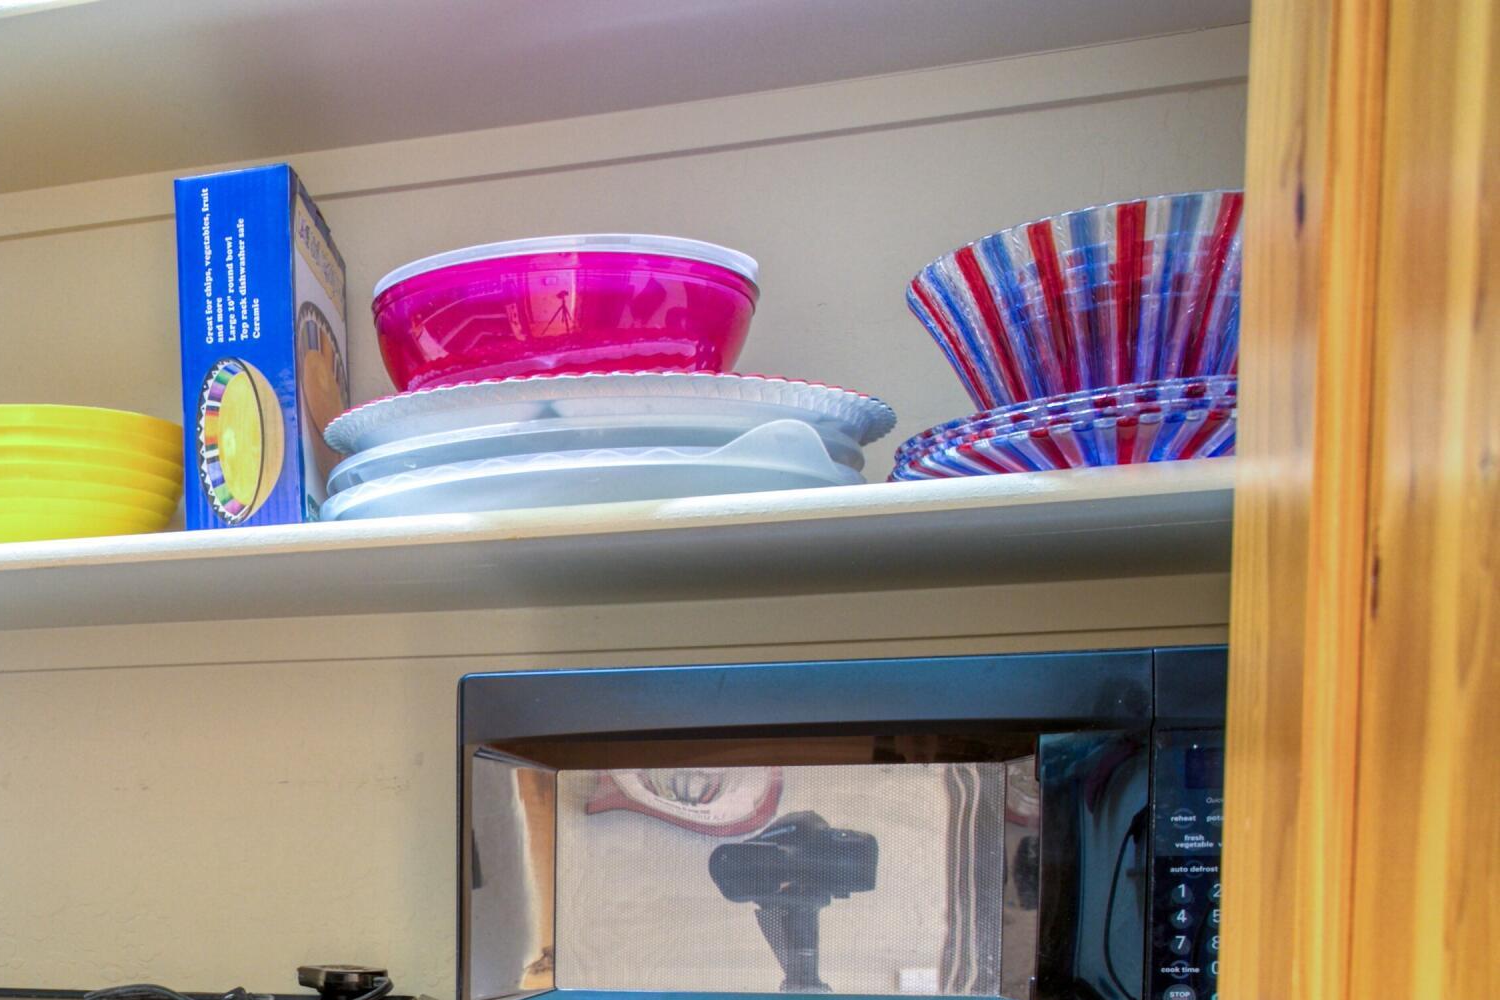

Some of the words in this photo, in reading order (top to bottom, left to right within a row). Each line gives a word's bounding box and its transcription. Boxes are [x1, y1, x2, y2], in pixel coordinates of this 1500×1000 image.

[200, 187, 209, 212] fruit
[202, 213, 212, 267] vegetables,
[236, 218, 244, 238] safe
[224, 236, 233, 262] bowl
[226, 262, 234, 293] round
[238, 239, 246, 296] dishwasher
[204, 268, 213, 297] chips,
[205, 299, 213, 315] for
[252, 298, 260, 339] Ceramic
[206, 316, 214, 344] Great
[216, 324, 224, 343] and
[228, 313, 237, 342] Large
[240, 322, 249, 341] Top
[1175, 841, 1214, 849] vegetable
[1178, 884, 1186, 898] 1
[1176, 909, 1186, 922] 4
[1212, 909, 1221, 923] 5
[1176, 936, 1186, 949] 7
[1212, 936, 1220, 949] 8
